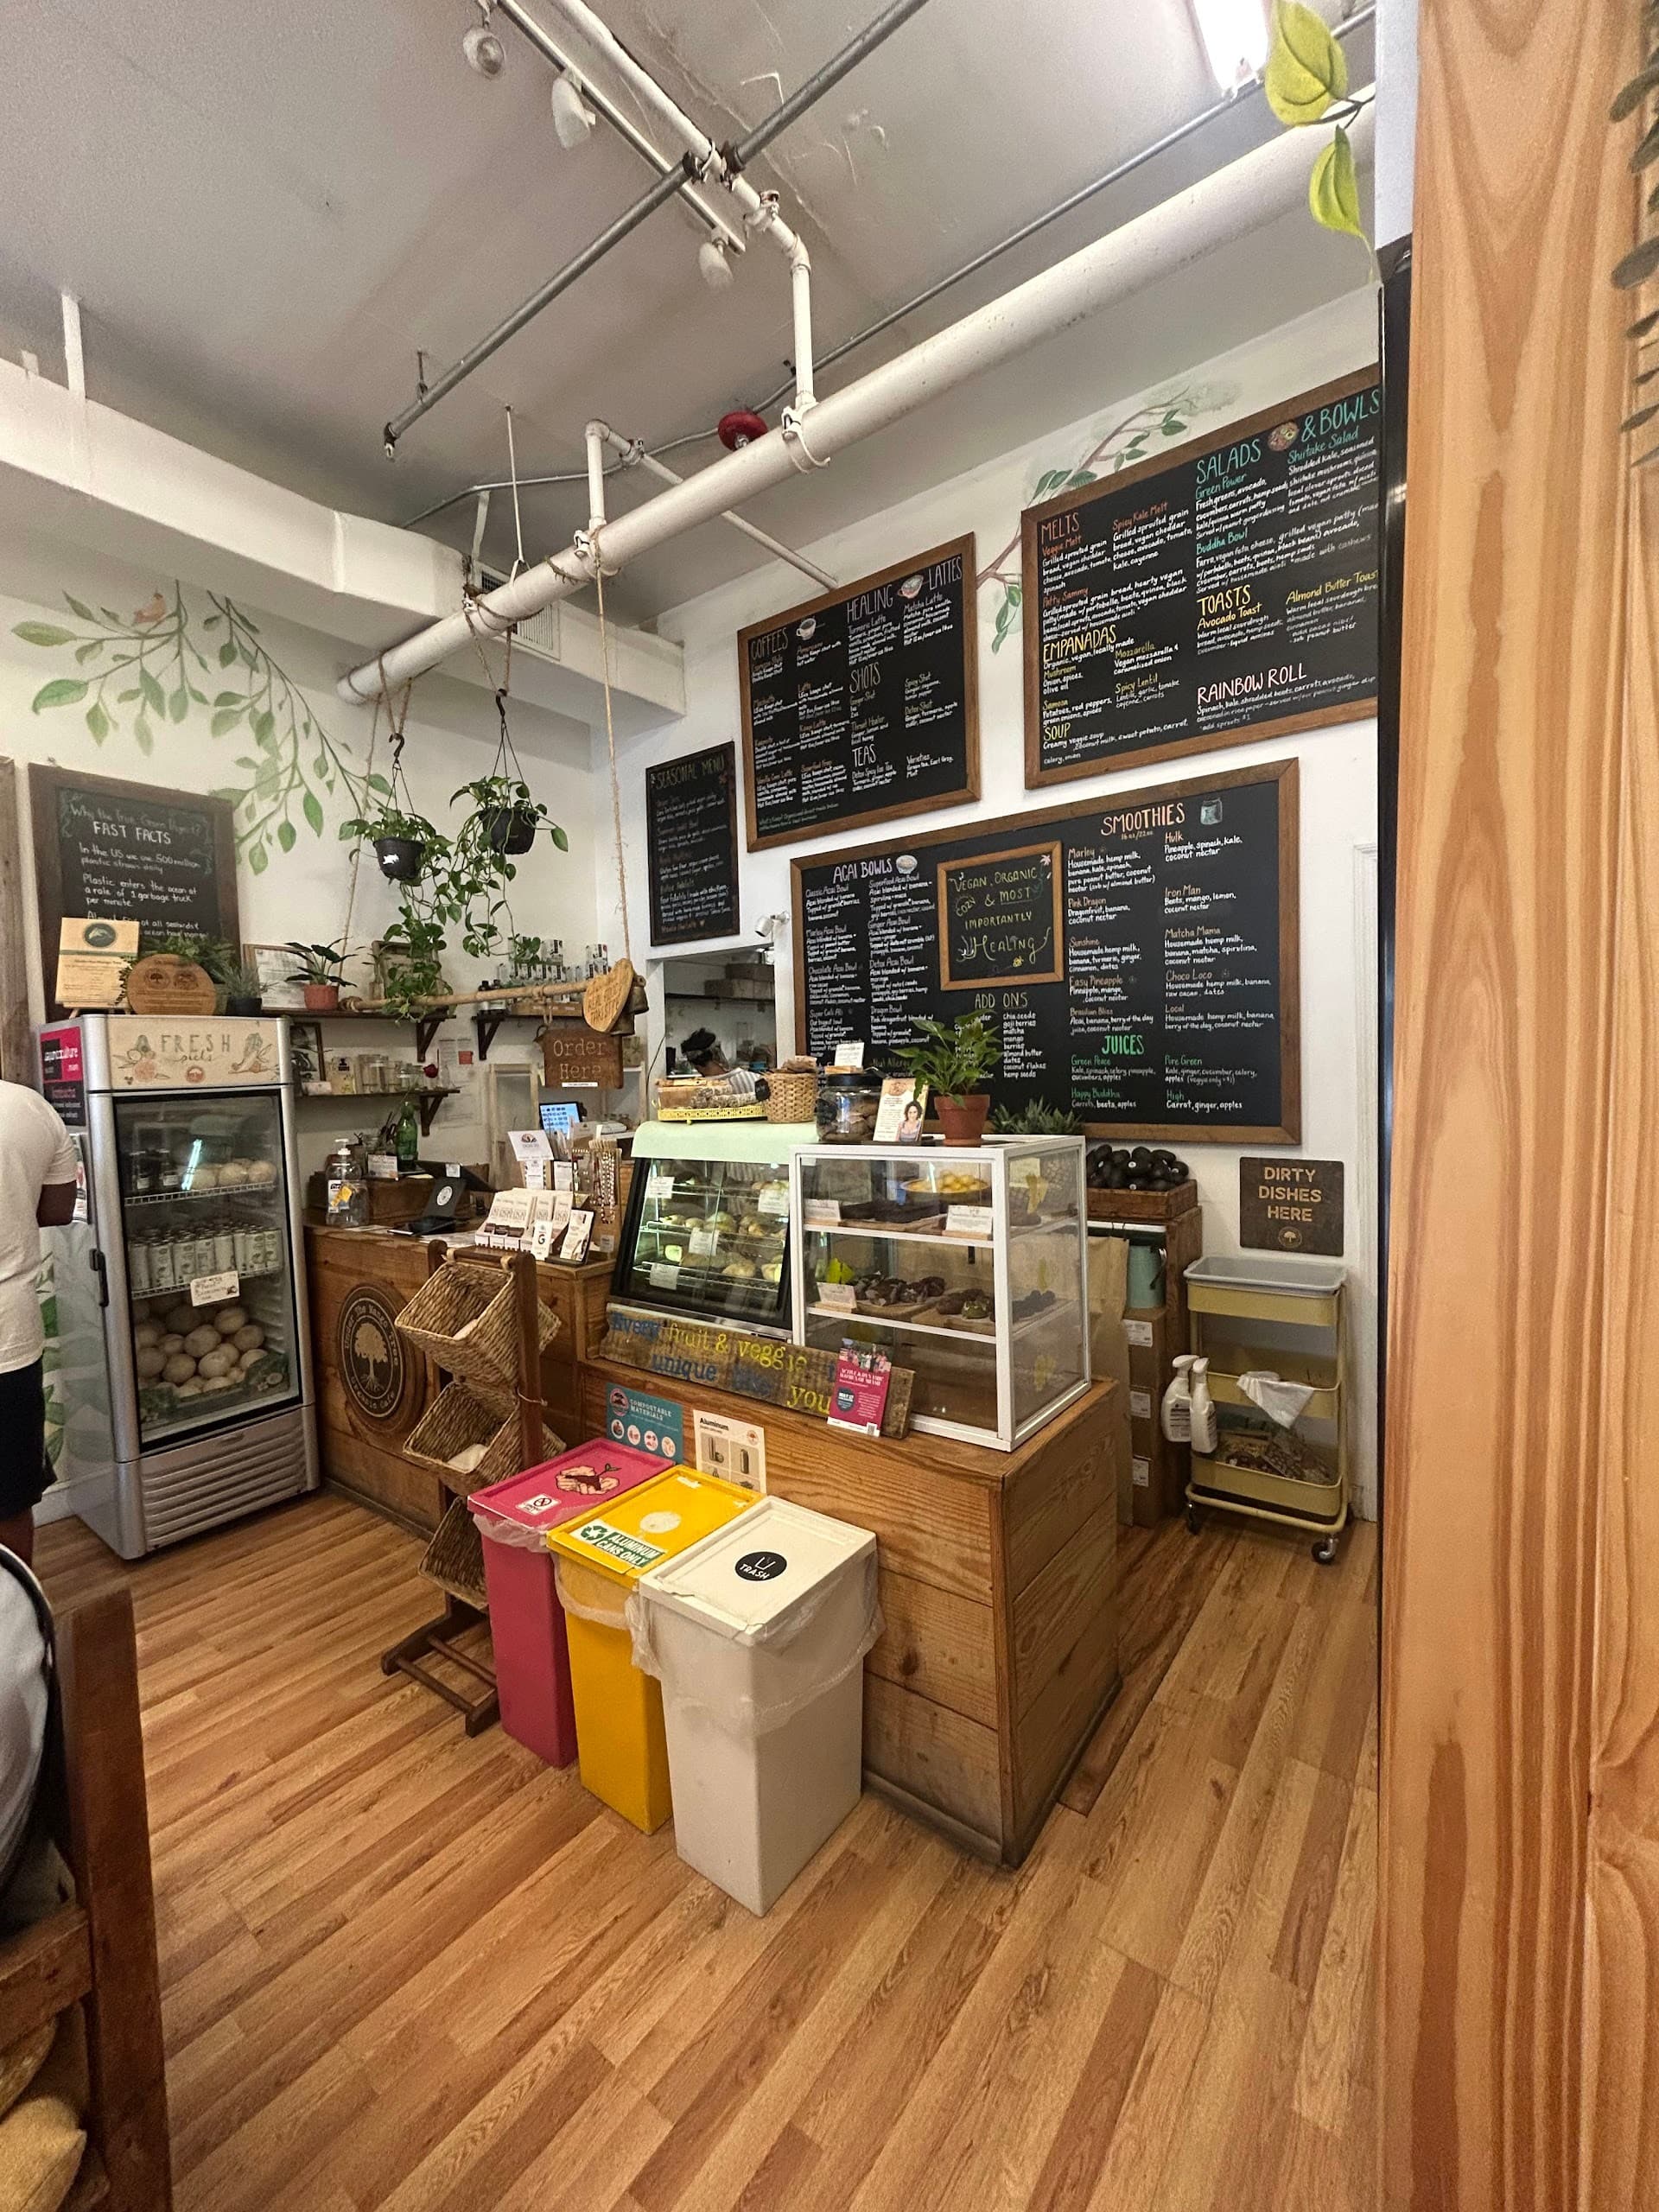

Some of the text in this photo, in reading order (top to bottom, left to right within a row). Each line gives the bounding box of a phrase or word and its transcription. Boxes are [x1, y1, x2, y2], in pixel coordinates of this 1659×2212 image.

[1196, 389, 1381, 485] SALADS & BOWLS
[1328, 425, 1359, 449] Salad
[1195, 473, 1247, 500] Green Power
[1112, 501, 1168, 533] Spicy Kale Melt
[1113, 526, 1136, 542] Grilled
[1137, 515, 1166, 533] sprouted
[1169, 509, 1189, 525] grain
[1278, 524, 1306, 544] grilled
[1307, 518, 1332, 535] vegan
[1333, 508, 1356, 527] patty
[1041, 512, 1079, 544] MELTS
[1135, 532, 1154, 544] vegan
[1154, 521, 1185, 537] cheddar
[1196, 526, 1248, 556] Buddha Bowl
[847, 556, 963, 623] HEALING LATTES
[1063, 588, 1089, 602] Sammy
[1286, 584, 1322, 605] Almond
[1325, 578, 1352, 592] Butter
[1197, 583, 1251, 616] TOASTS
[1197, 610, 1236, 631] Avocado
[1238, 602, 1262, 618] Toast
[751, 626, 789, 660] COFFEES
[1043, 624, 1116, 663] EMPANADAS
[1115, 640, 1155, 659] Mozzarella
[1115, 657, 1135, 669] Vegan
[849, 661, 881, 694] SHOTS
[1115, 672, 1159, 695] Spicy Lentil
[1197, 662, 1306, 705] RAINBOW ROLL
[1043, 721, 1071, 741] SOUP
[851, 744, 876, 767] TEAS
[1101, 803, 1185, 836] SMOOTHIES
[92, 820, 171, 844] FAST FACTS
[1165, 830, 1184, 843] Hulk
[1224, 835, 1243, 846] kale,
[1068, 847, 1095, 860] Marley
[1165, 848, 1220, 861] coconut nectar
[833, 857, 893, 884] ACAI BOWLS
[995, 867, 1037, 884] ORGANIC
[82, 873, 115, 887] Plastic
[150, 880, 164, 892] the
[1165, 884, 1201, 898] Iron Man
[86, 897, 99, 906] per
[138, 891, 169, 903] garbage
[985, 893, 995, 906] &
[1000, 887, 1030, 902] MOST
[1068, 896, 1107, 908] Pink Dragon
[1212, 892, 1236, 900] lemon,
[964, 911, 1033, 931] IMPORTANTLY
[1164, 925, 1221, 939] Matcha Mama
[1069, 936, 1100, 948] Sunshine
[1069, 975, 1123, 988] Easy Pineapple
[1166, 968, 1213, 982] Choco Loco
[975, 992, 1028, 1009] ADD ONS
[1165, 1003, 1185, 1014] Local
[1017, 1010, 1036, 1020] seeds
[161, 1033, 230, 1052] FRESH
[552, 1039, 607, 1057] Order
[1025, 1047, 1043, 1056] butter
[1101, 1035, 1145, 1055] JUICES
[1071, 1054, 1092, 1065] Green
[1180, 1054, 1203, 1065] Green
[560, 1063, 601, 1079] Here
[1003, 1071, 1020, 1079] hemp
[1071, 1088, 1121, 1099] Happy Buddha
[1166, 1089, 1184, 1102] High
[1166, 1100, 1243, 1113] Carrot, ginger, apples
[1263, 1166, 1316, 1183] DIRTY
[1257, 1185, 1322, 1203] DISHES
[1267, 1205, 1313, 1222] HERE
[668, 1322, 710, 1351] fruit
[715, 1333, 727, 1353] &
[738, 1340, 807, 1372] veggie
[652, 1353, 718, 1382] unique
[786, 1384, 831, 1415] you
[629, 1398, 672, 1417] COMPOSTABLE
[630, 1404, 664, 1421] MATERIALS
[699, 1417, 729, 1431] Aluminum
[597, 1539, 647, 1566] CANS ONLY
[612, 1531, 661, 1558] ALUMINUM
[739, 1563, 771, 1580] TRASH
